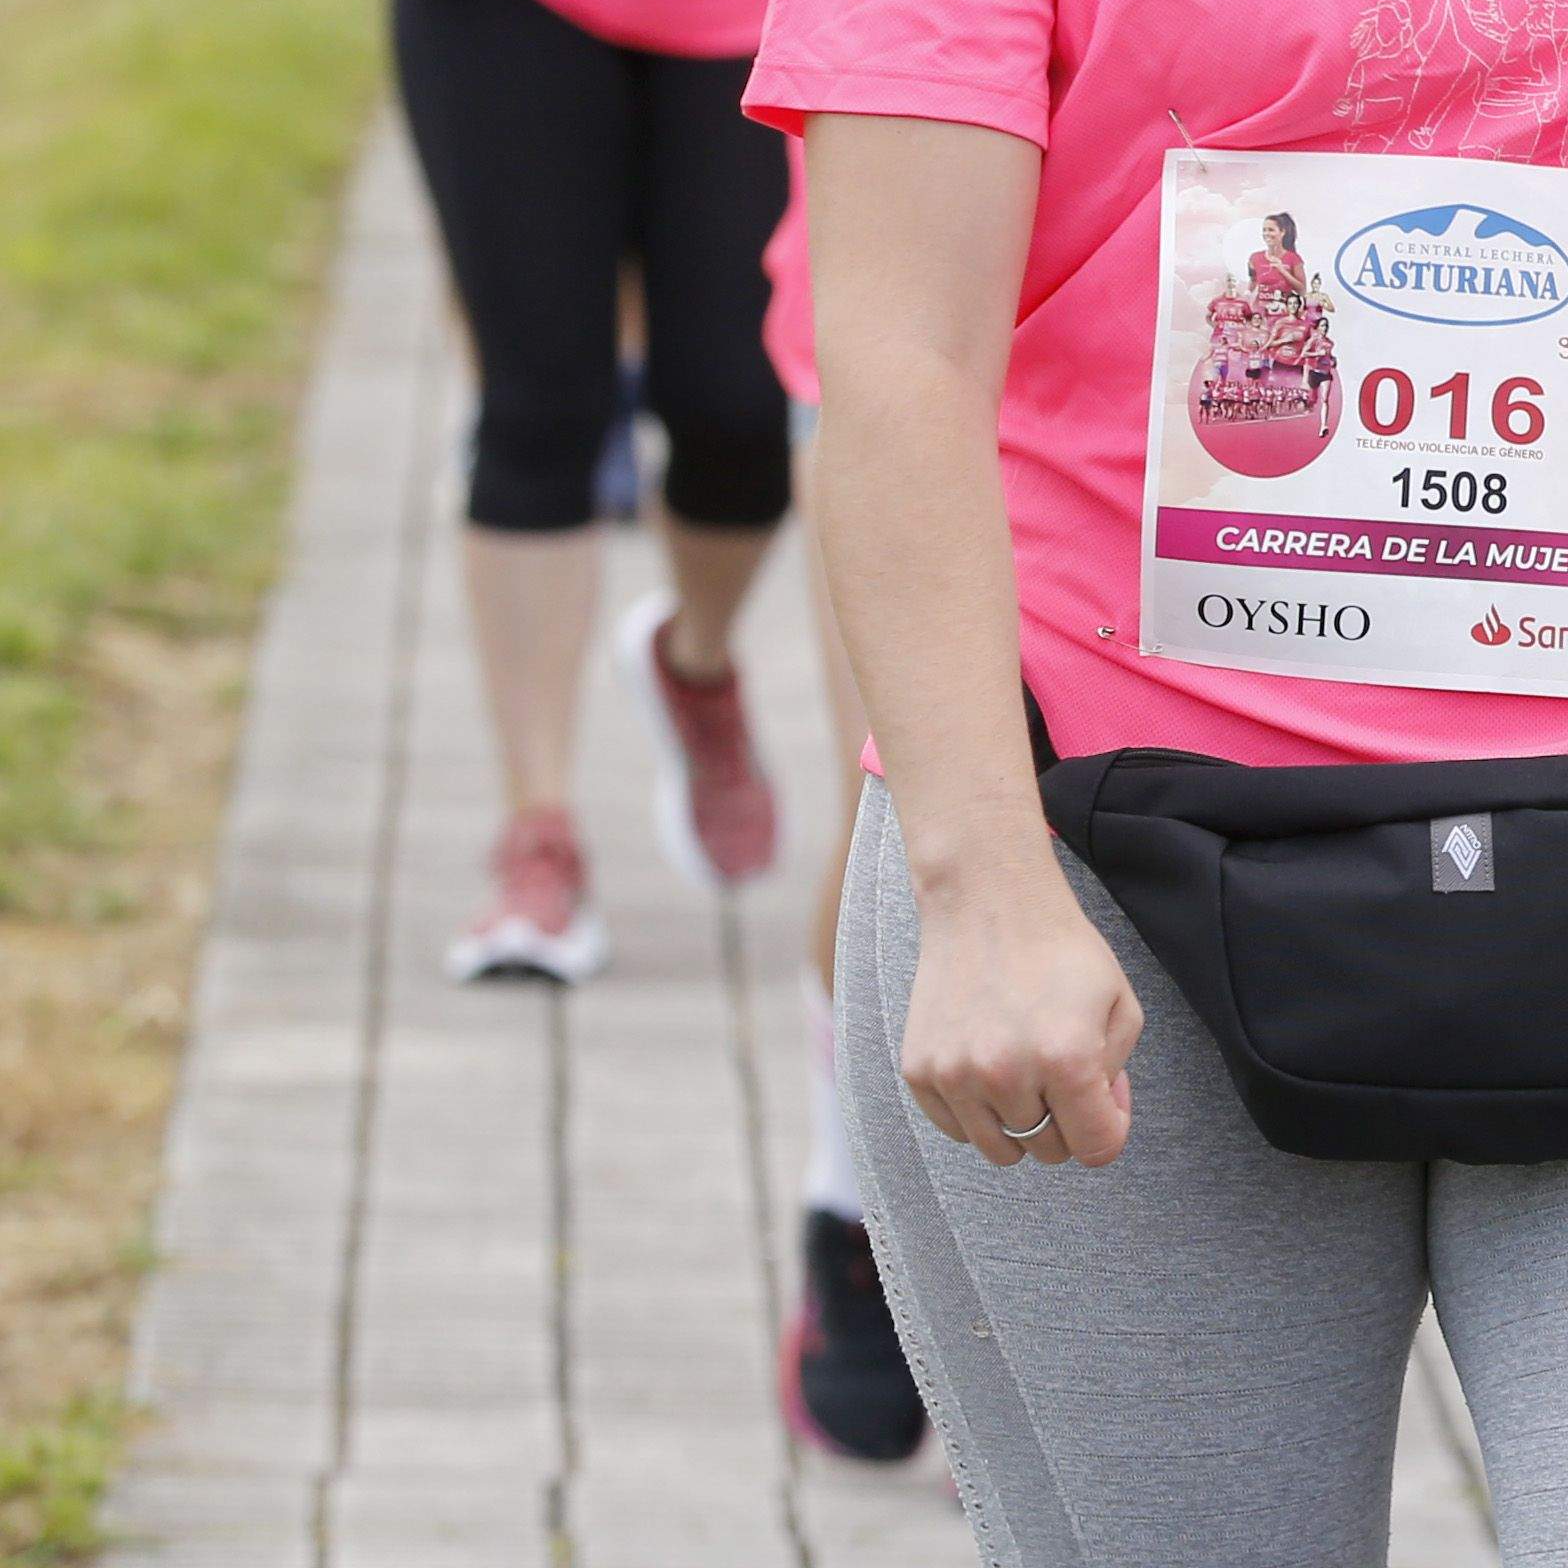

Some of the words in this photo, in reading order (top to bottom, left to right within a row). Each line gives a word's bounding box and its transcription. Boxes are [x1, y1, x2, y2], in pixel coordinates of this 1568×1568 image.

[1354, 243, 1559, 301] ASTURIANA
[1394, 242, 1473, 259] CENTRAL
[1481, 248, 1554, 265] LECHERA
[1358, 367, 1545, 445] 016
[1356, 437, 1415, 452] TELÉFONO
[1418, 442, 1479, 455] VIOLENCIA
[1482, 446, 1496, 458] DE
[1499, 445, 1544, 461] GÉNERO
[1392, 467, 1507, 514] 1508
[1216, 526, 1372, 561] CARRERA
[1382, 534, 1428, 565] DE
[1435, 539, 1476, 567] LA
[1197, 594, 1371, 641] OYSHO
